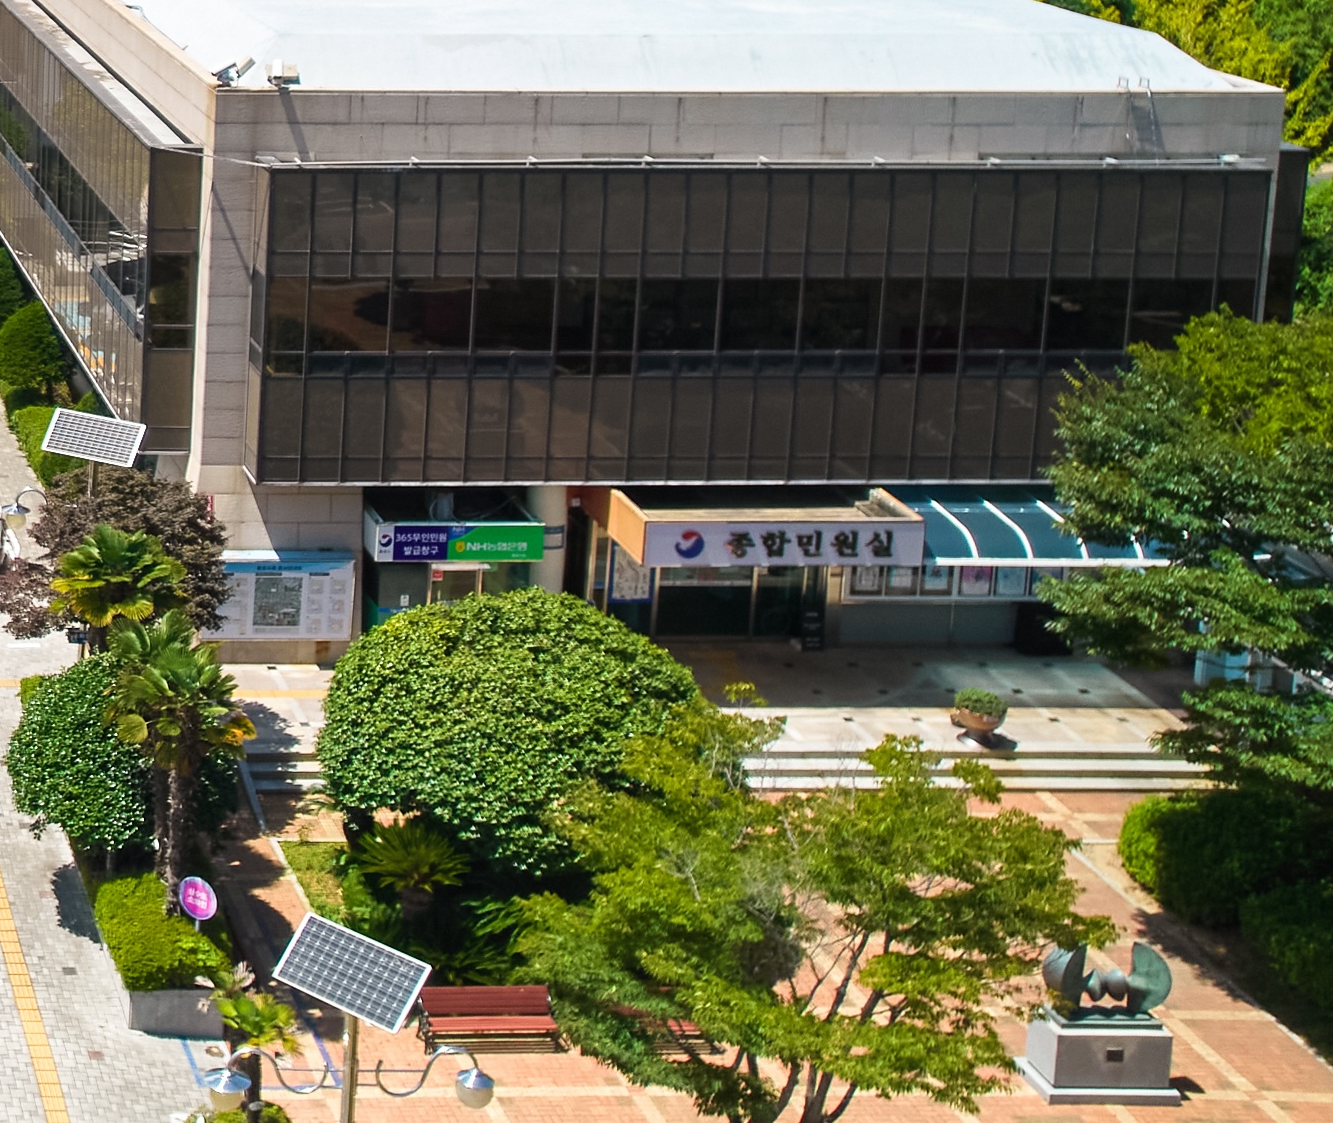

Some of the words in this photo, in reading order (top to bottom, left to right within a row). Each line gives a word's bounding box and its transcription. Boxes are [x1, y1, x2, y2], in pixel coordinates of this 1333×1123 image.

[395, 532, 448, 544] 365무인민원
[728, 529, 895, 559] 종합민원실
[403, 545, 440, 556] 발급창구
